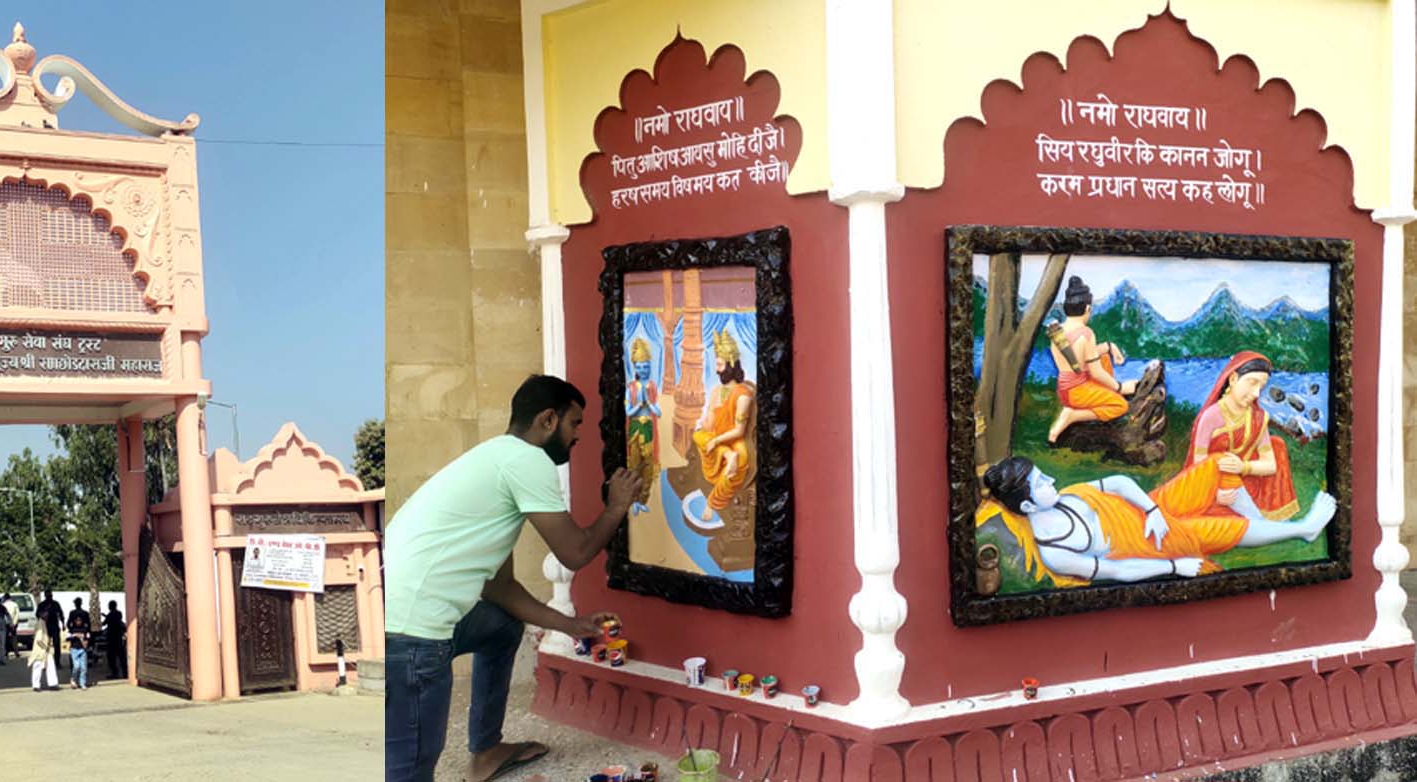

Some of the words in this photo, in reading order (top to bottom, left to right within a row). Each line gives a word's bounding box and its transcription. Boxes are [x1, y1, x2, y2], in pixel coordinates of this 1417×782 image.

[1077, 94, 1118, 126] नमो
[1123, 105, 1189, 129] राघवाय
[717, 132, 748, 160] मोहि
[1036, 133, 1075, 163] सिय
[1158, 145, 1210, 167] कानन
[1213, 139, 1256, 177] जोगू
[1037, 173, 1084, 196] करम
[1088, 175, 1137, 197] प्रधान
[1141, 177, 1178, 201] सत्य
[1181, 180, 1214, 204] कह
[1215, 174, 1255, 210] लोगू
[22, 332, 46, 349] सेवा
